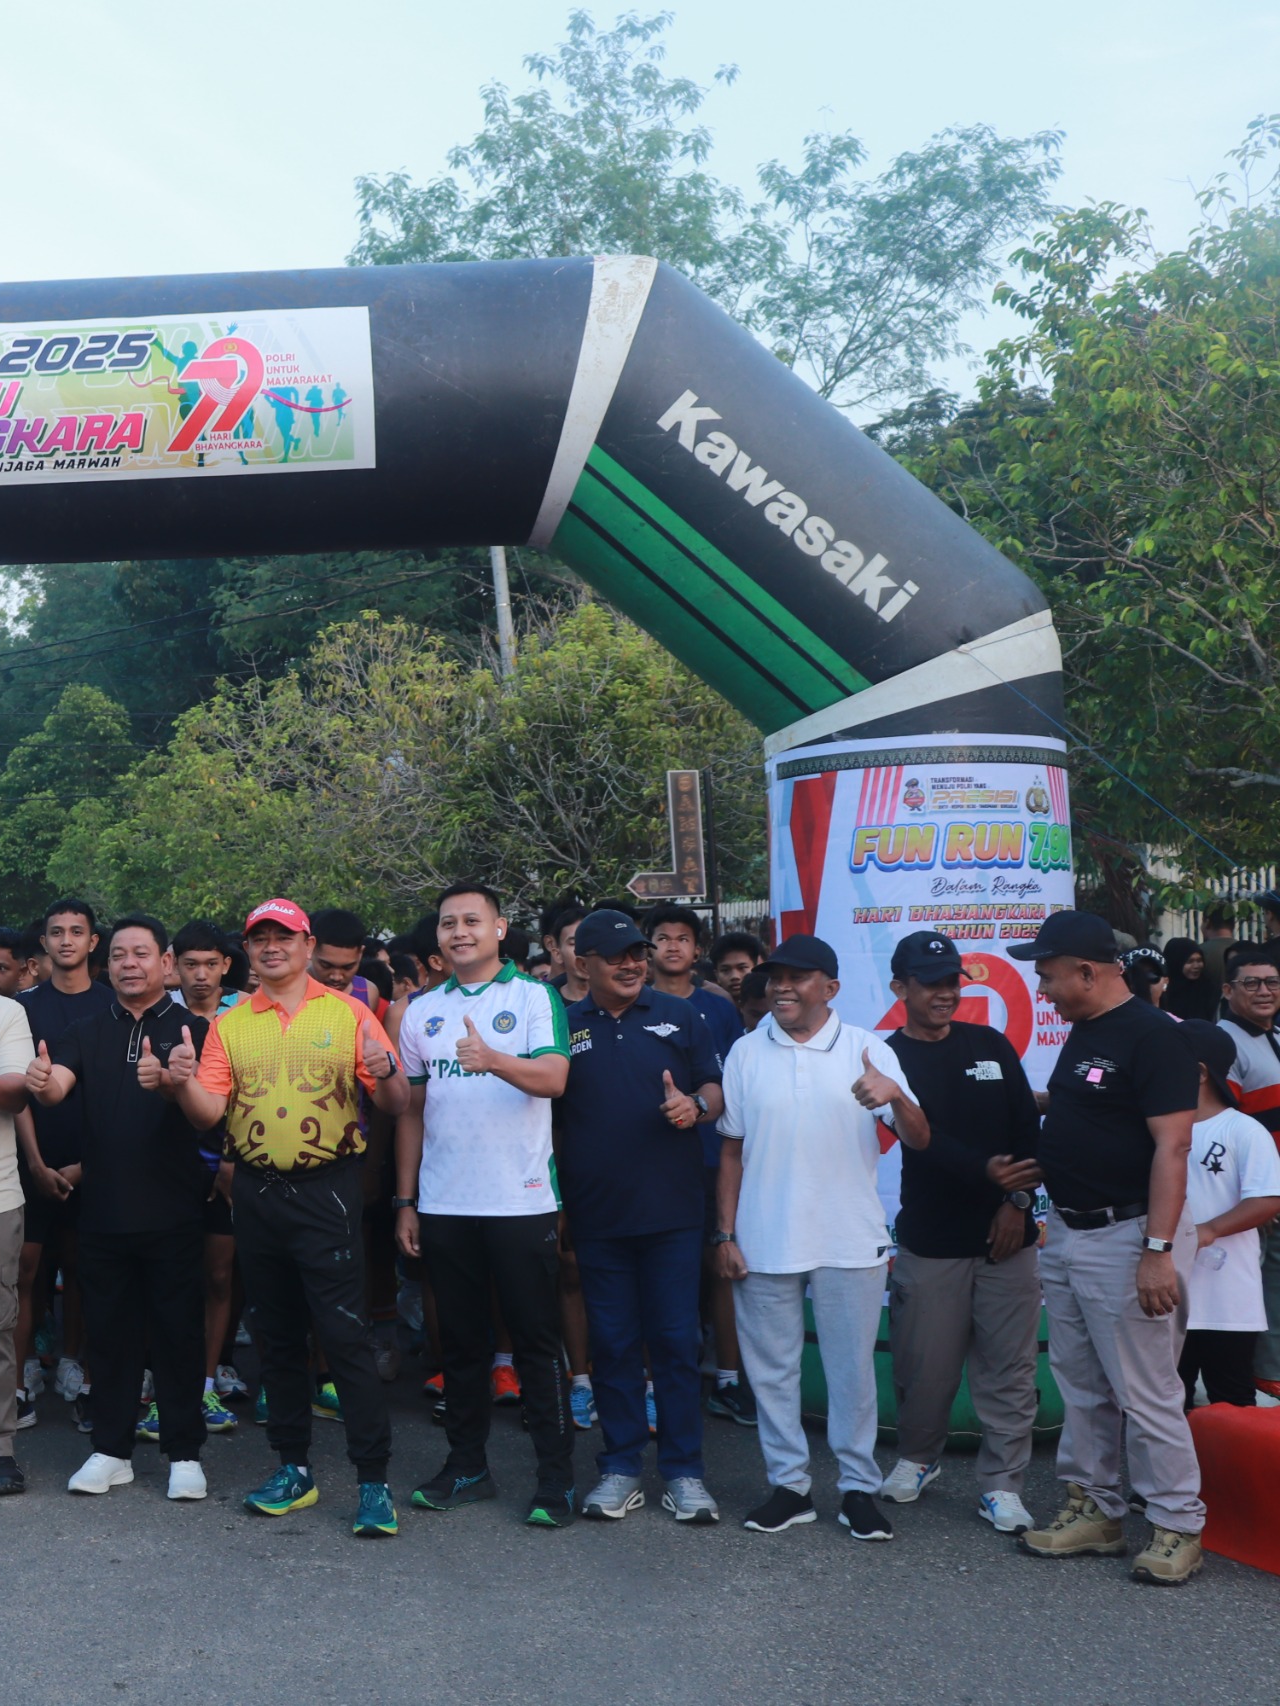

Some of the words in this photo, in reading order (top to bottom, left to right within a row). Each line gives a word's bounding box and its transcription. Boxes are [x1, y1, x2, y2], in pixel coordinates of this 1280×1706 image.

[266, 354, 295, 362] POLRI
[266, 365, 299, 374] UNTUK
[266, 374, 332, 386] MASYARAKAT
[209, 433, 232, 441] HARI
[195, 440, 262, 451] BHAYANGKARA
[53, 457, 122, 470] MARWAH
[656, 389, 920, 623] Kawasaki
[851, 824, 935, 869] FUN
[943, 823, 1024, 867] RUN
[932, 877, 986, 897] Dalam
[992, 876, 1042, 898] Rangka
[853, 906, 902, 923] HARI
[909, 904, 1046, 921] BHAYANGKARA
[934, 924, 995, 939] TAHUN
